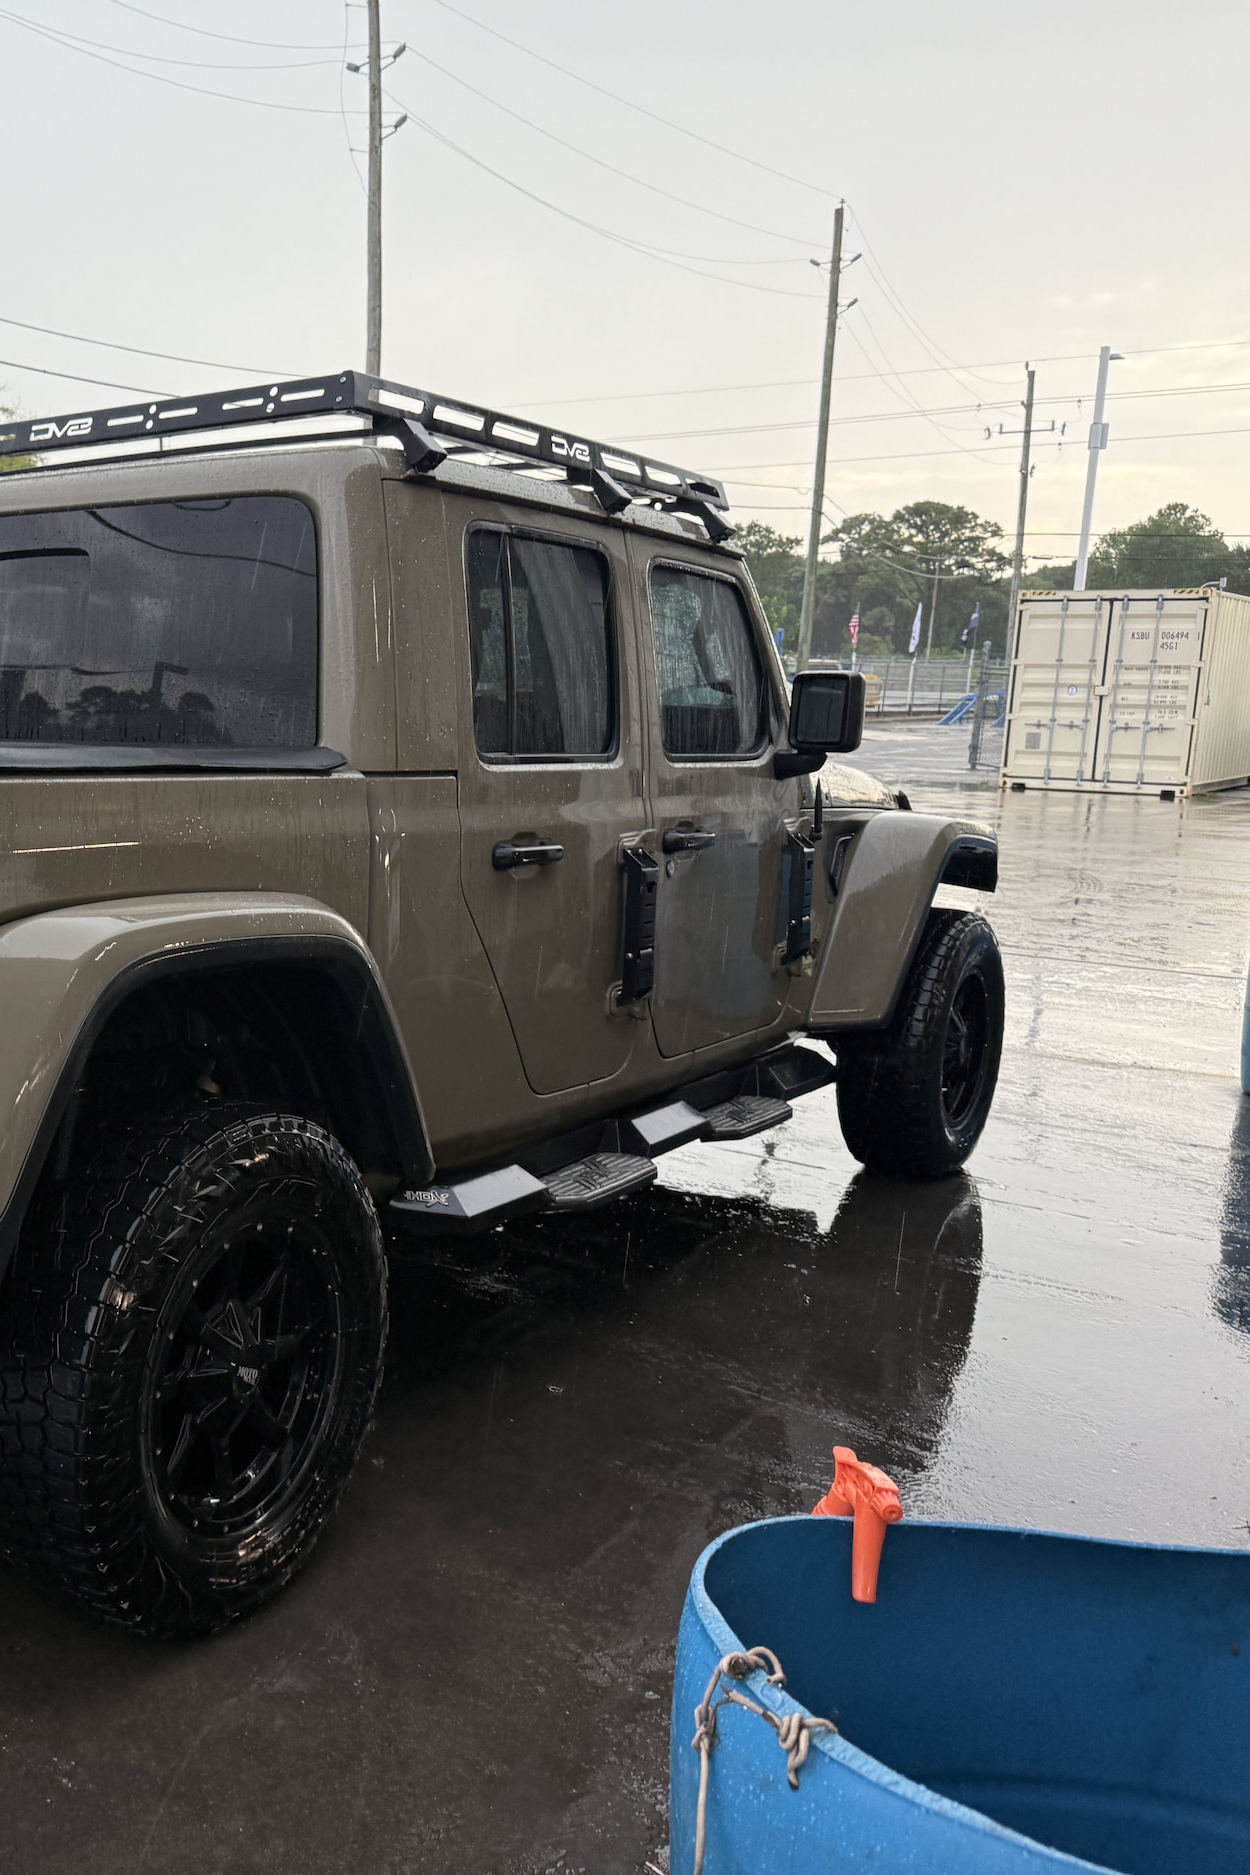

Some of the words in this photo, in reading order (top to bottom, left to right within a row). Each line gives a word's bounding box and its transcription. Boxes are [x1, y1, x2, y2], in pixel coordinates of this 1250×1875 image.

[29, 417, 93, 441] DV8
[551, 435, 590, 462] DV8
[1131, 632, 1150, 640] KSBU
[1161, 632, 1189, 640] 006494
